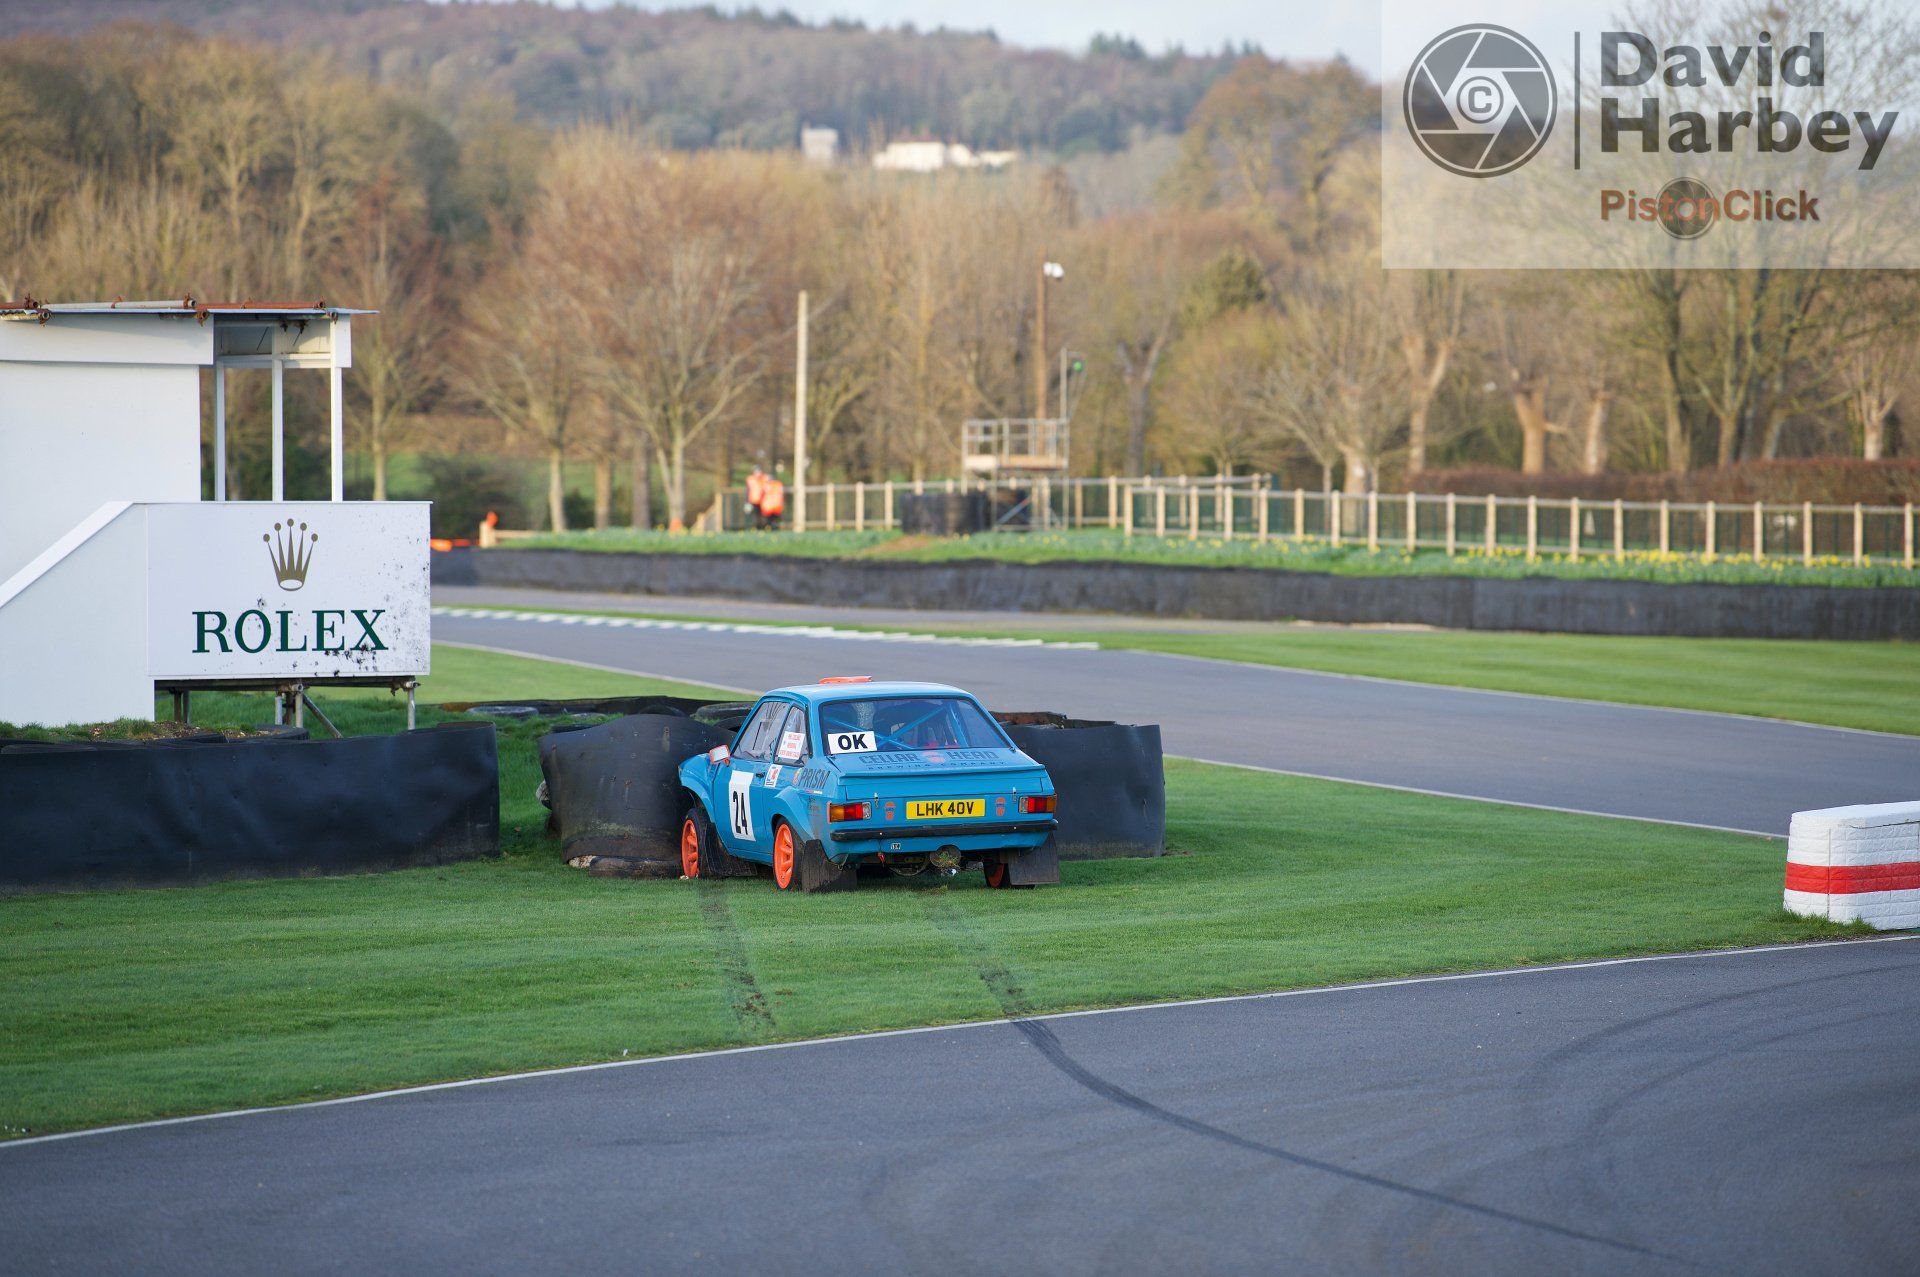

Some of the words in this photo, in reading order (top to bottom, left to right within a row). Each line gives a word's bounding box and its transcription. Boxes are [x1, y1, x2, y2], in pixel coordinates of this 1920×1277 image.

[192, 609, 389, 654] ROLEX
[837, 733, 869, 751] OK
[859, 753, 920, 764] CELLAR
[946, 751, 1000, 760] HEAD
[798, 768, 831, 790] PRISM
[732, 790, 749, 835] 24
[916, 802, 944, 816] LHK
[948, 801, 974, 815] 40V
